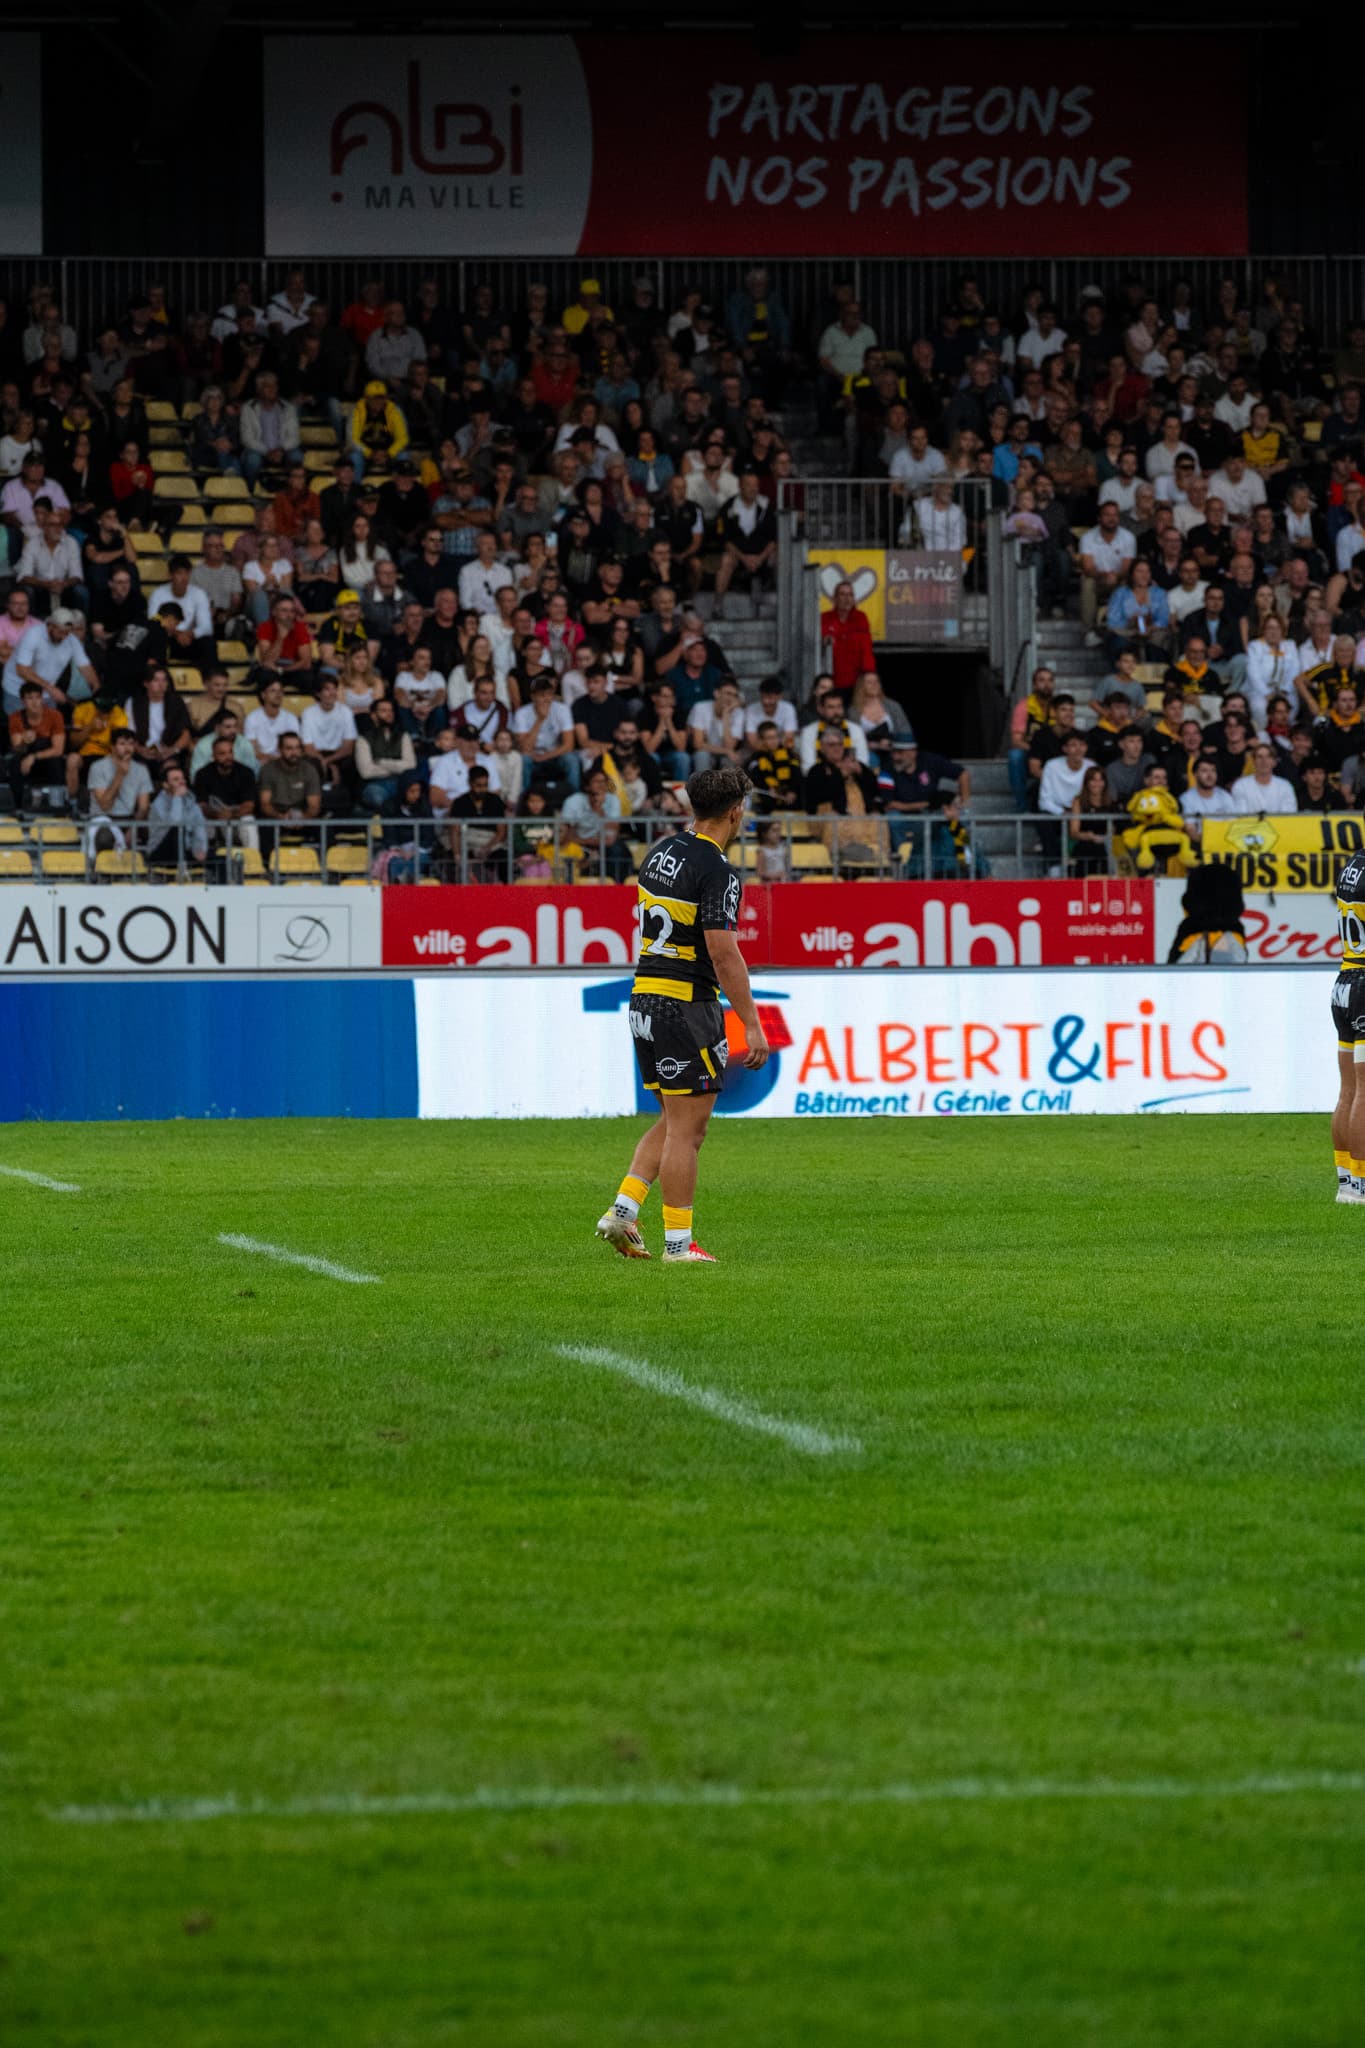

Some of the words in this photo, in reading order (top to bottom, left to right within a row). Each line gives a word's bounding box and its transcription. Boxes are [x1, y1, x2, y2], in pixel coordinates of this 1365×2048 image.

[707, 82, 1094, 142] PARTAGEONS
[365, 186, 416, 209] MA
[429, 186, 524, 209] VILLE
[706, 157, 828, 208] NOS
[848, 157, 1132, 215] PASSIONS
[1212, 853, 1277, 887] OS
[5, 906, 226, 964] AISON
[413, 930, 466, 955] ville
[475, 903, 640, 966] alb
[801, 927, 853, 952] ville
[861, 898, 1042, 967] albi
[794, 1090, 910, 1114] Bâtiment
[933, 1089, 1012, 1113] Génie
[1021, 1089, 1073, 1112] Civil
